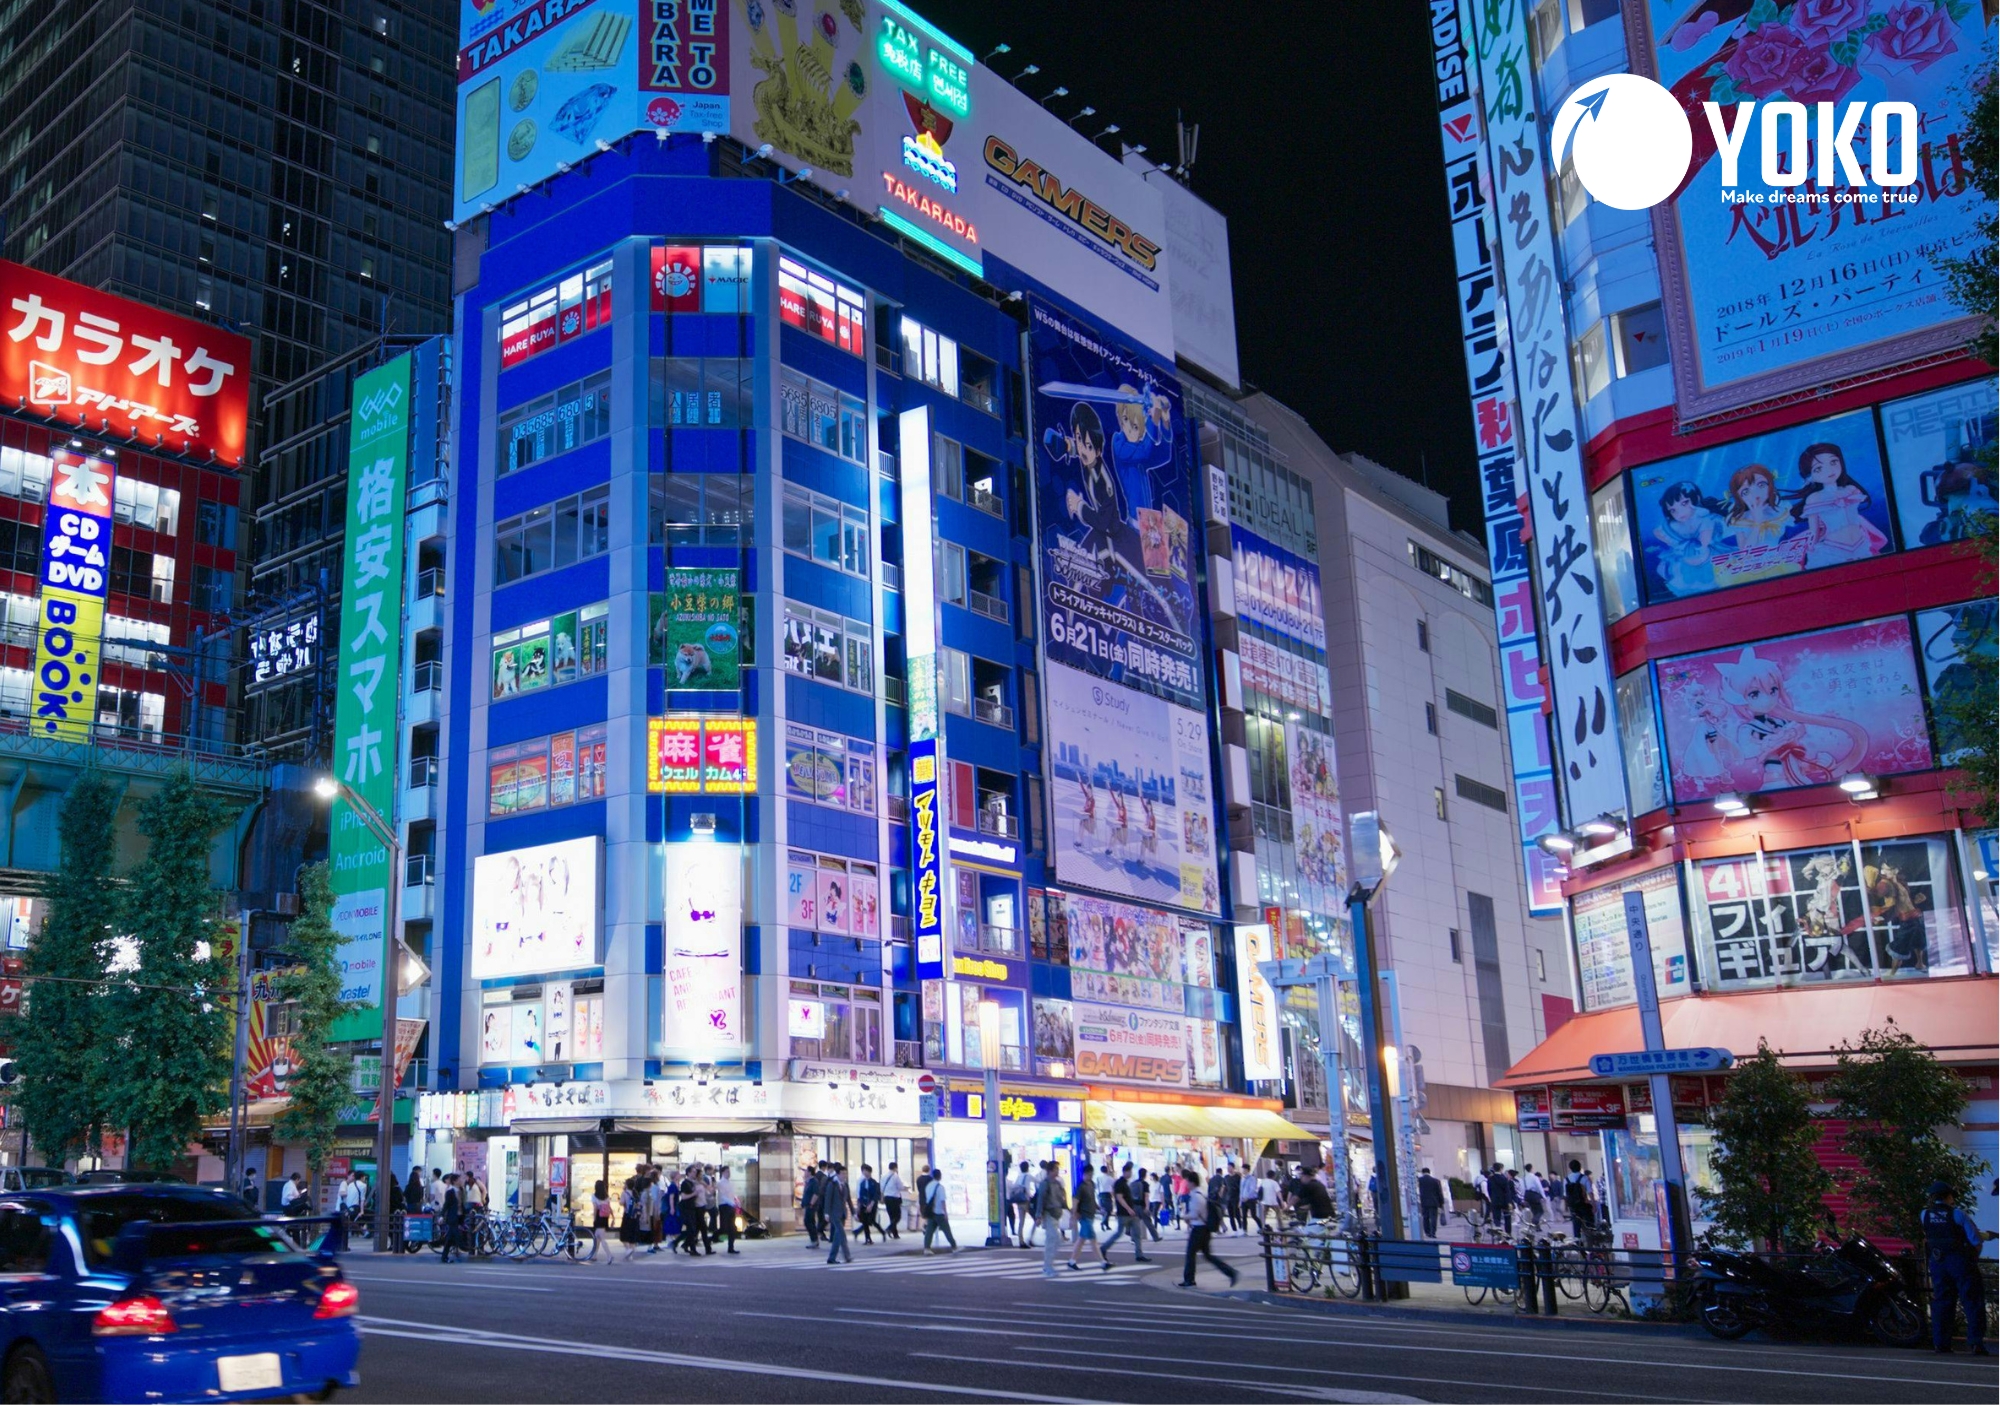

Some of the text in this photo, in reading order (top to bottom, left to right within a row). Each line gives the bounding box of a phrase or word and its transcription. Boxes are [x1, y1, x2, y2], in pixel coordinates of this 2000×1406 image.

[882, 16, 967, 86] TAX FREE
[701, 120, 722, 128] Shop
[882, 172, 978, 244] TAKARADA
[983, 135, 1162, 273] GAMERS
[718, 275, 749, 284] MAGIC
[780, 297, 834, 330] HARE RUYA
[8, 293, 235, 397] カラオケ
[503, 326, 555, 358] HARE RUYA
[75, 386, 200, 436] アドアーズ
[360, 413, 398, 440] mobile
[55, 462, 110, 507] 本
[60, 512, 100, 541] CD
[49, 535, 105, 568] ゲーム
[48, 561, 103, 591] DVD
[343, 455, 396, 784] 格安スマホ
[1138, 622, 1146, 635] &
[1051, 612, 1199, 693] 6月21日(金)同時発売!
[1105, 692, 1131, 715] Study
[1176, 717, 1203, 741] 5.29
[659, 732, 742, 764] 麻雀
[336, 845, 386, 873] Android
[789, 872, 802, 893] 2F
[1708, 862, 1781, 898] 4F
[801, 899, 814, 921] 3F
[1629, 905, 1643, 951] 中央通り
[669, 966, 692, 982] CAFE
[1077, 1050, 1187, 1084] GAMERS
[594, 1089, 604, 1098] 24
[753, 1089, 767, 1099] 24
[1606, 1103, 1621, 1113] 3F
